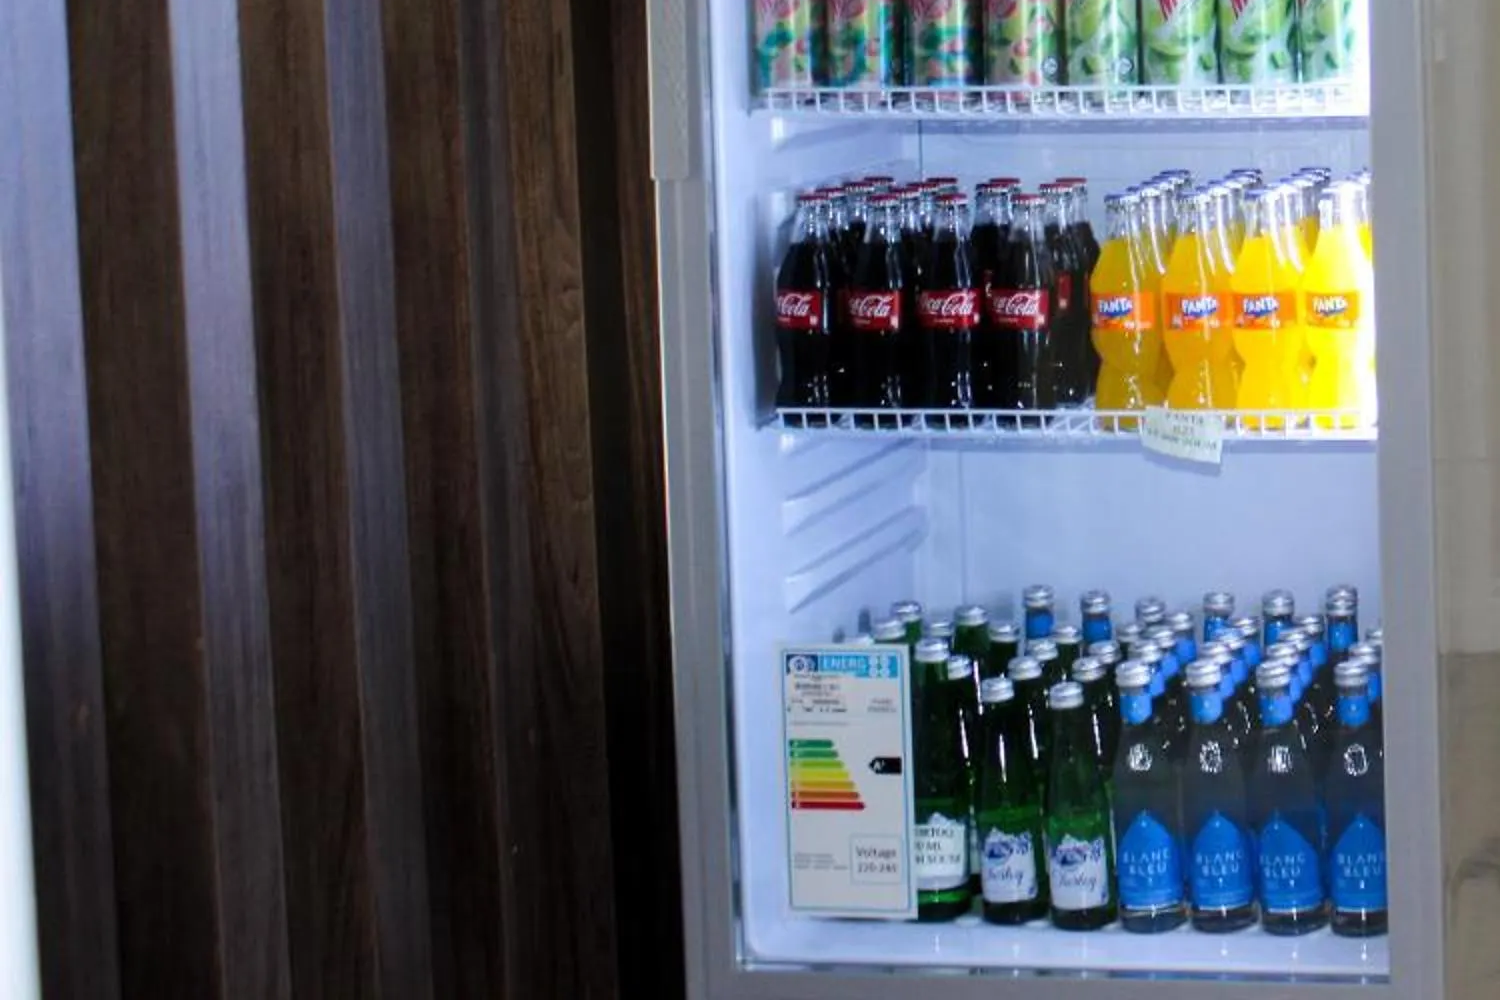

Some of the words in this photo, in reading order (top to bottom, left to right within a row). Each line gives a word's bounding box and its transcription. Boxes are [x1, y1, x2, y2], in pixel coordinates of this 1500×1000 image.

[1099, 297, 1133, 312] FANTA
[1182, 296, 1219, 314] FANTA
[1243, 296, 1280, 313] FANTA
